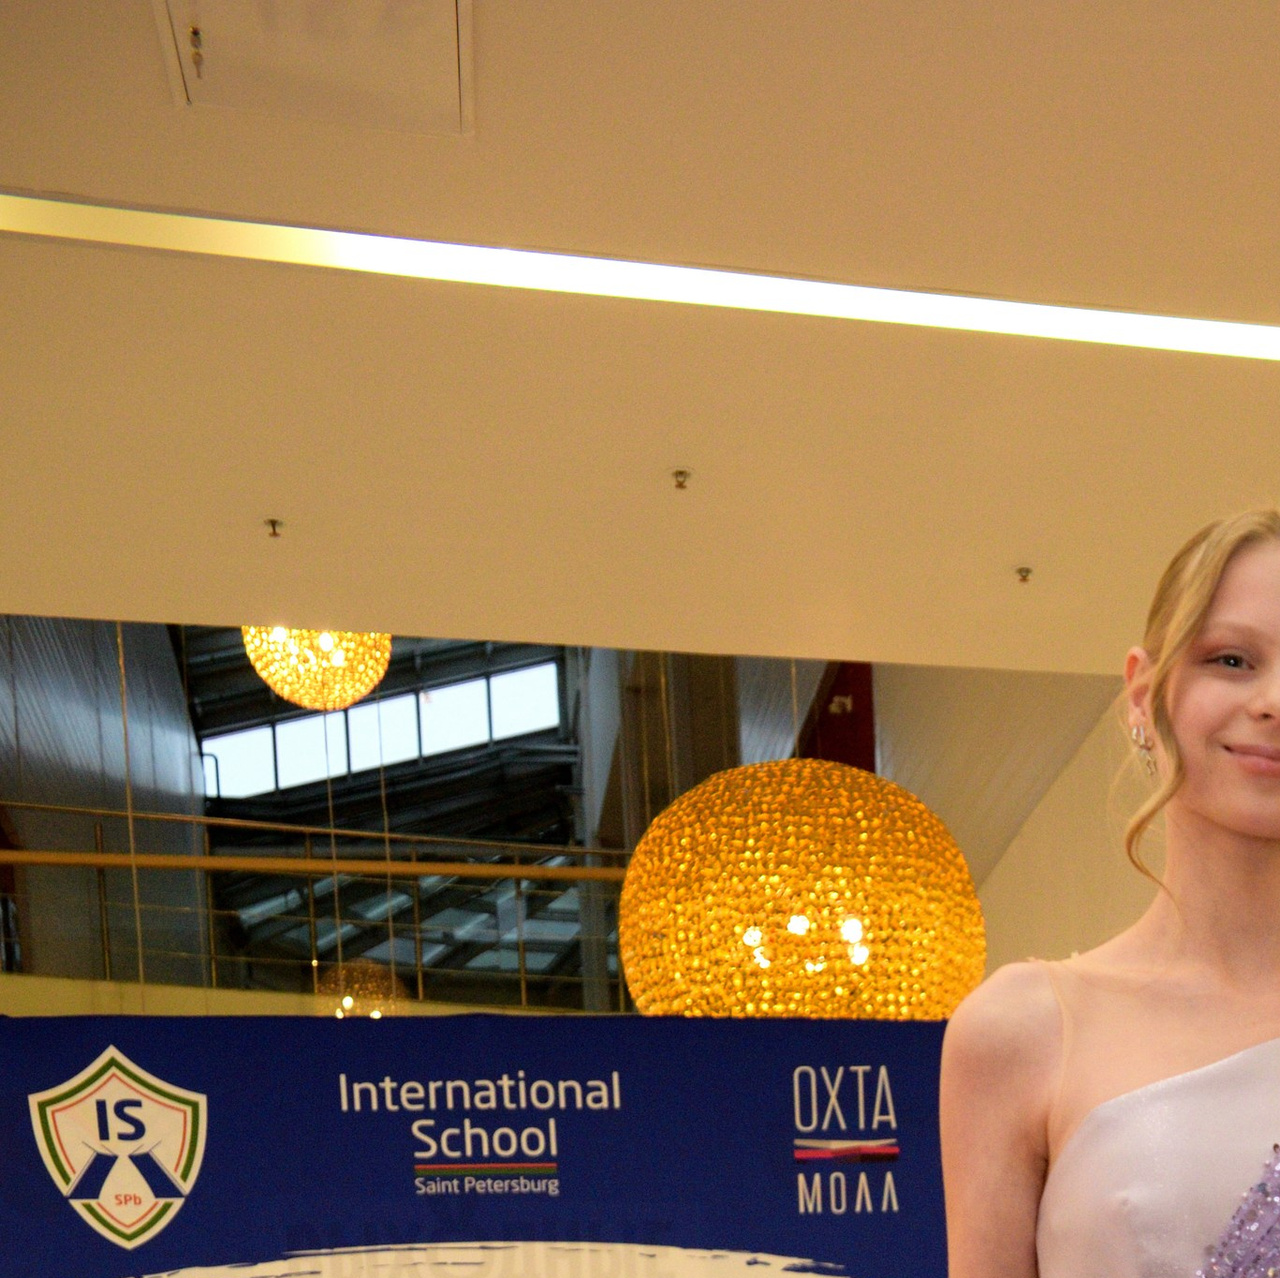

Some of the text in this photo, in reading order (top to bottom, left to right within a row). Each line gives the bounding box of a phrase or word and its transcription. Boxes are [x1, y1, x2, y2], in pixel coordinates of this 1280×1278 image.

[339, 1070, 620, 1112] International
[793, 1065, 898, 1132] ОХТА
[95, 1099, 146, 1141] IS
[411, 1117, 558, 1158] School
[114, 1194, 143, 1207] SPb
[414, 1176, 560, 1196] Saint Petersburg
[797, 1171, 899, 1215] МОЛЛ
